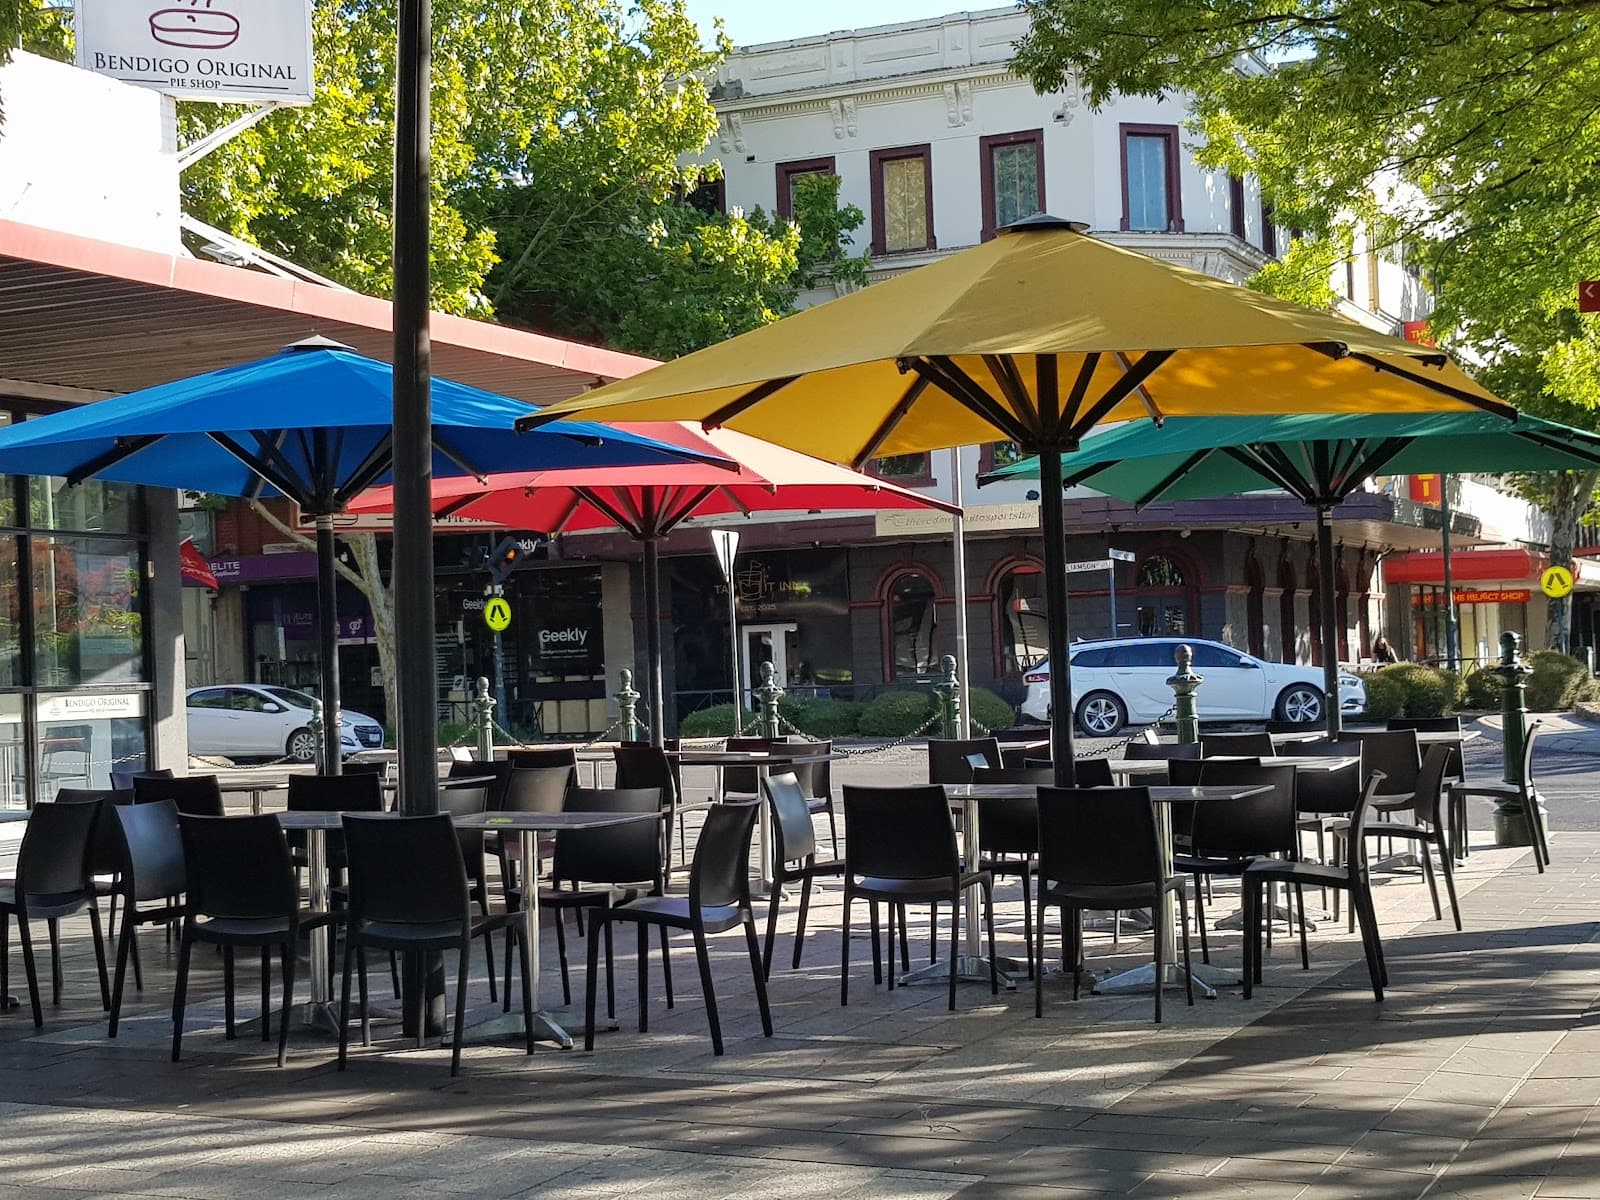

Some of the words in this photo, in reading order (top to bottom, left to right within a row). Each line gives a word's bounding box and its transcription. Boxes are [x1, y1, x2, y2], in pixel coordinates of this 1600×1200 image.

[95, 52, 190, 74] BENDIGO
[196, 58, 297, 80] ORIGINAL
[170, 78, 187, 88] PIE
[190, 79, 221, 89] SHOP
[1501, 591, 1524, 600] SHOP
[538, 627, 588, 646] Geekly
